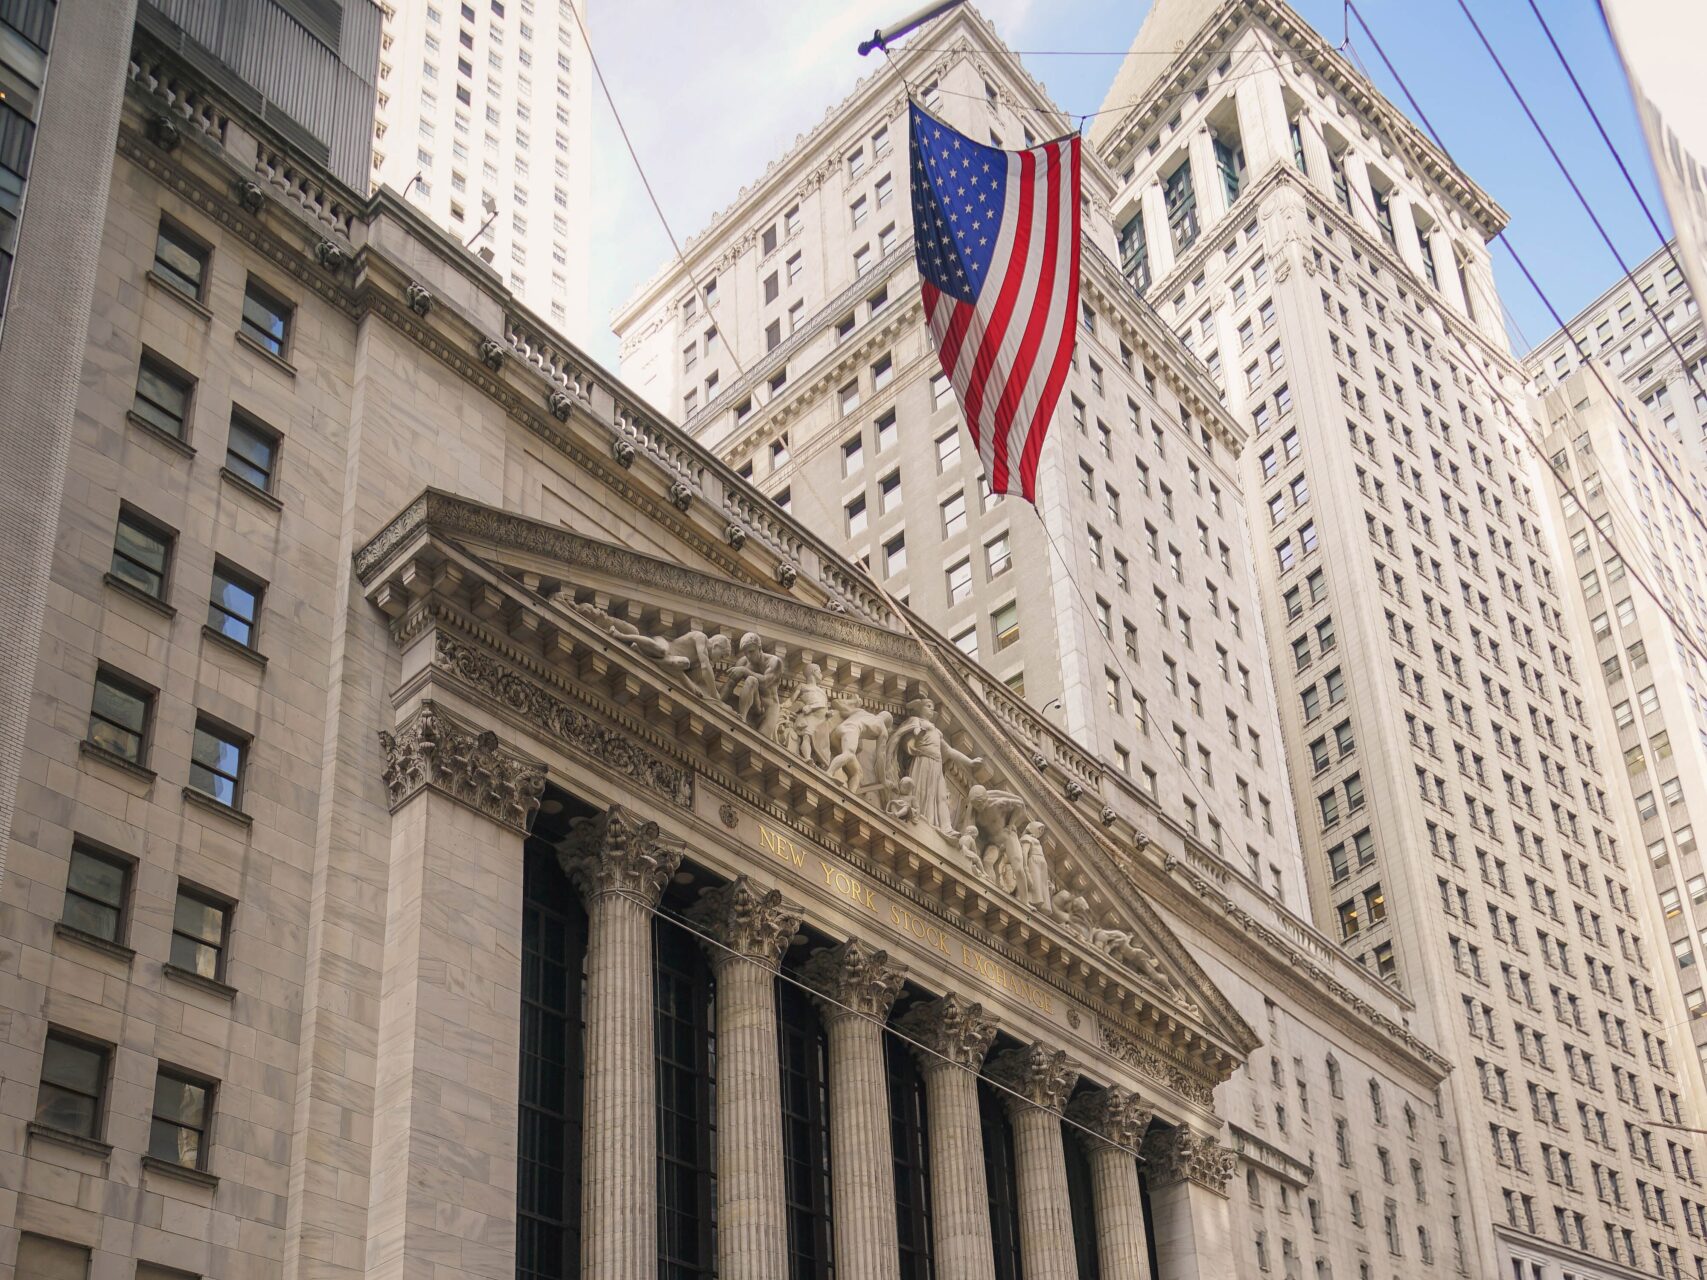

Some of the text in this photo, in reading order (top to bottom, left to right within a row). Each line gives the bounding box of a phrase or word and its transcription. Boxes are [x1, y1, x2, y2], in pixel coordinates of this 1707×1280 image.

[758, 825, 1055, 1015] NEW YORK STOCK EXCHANGE
